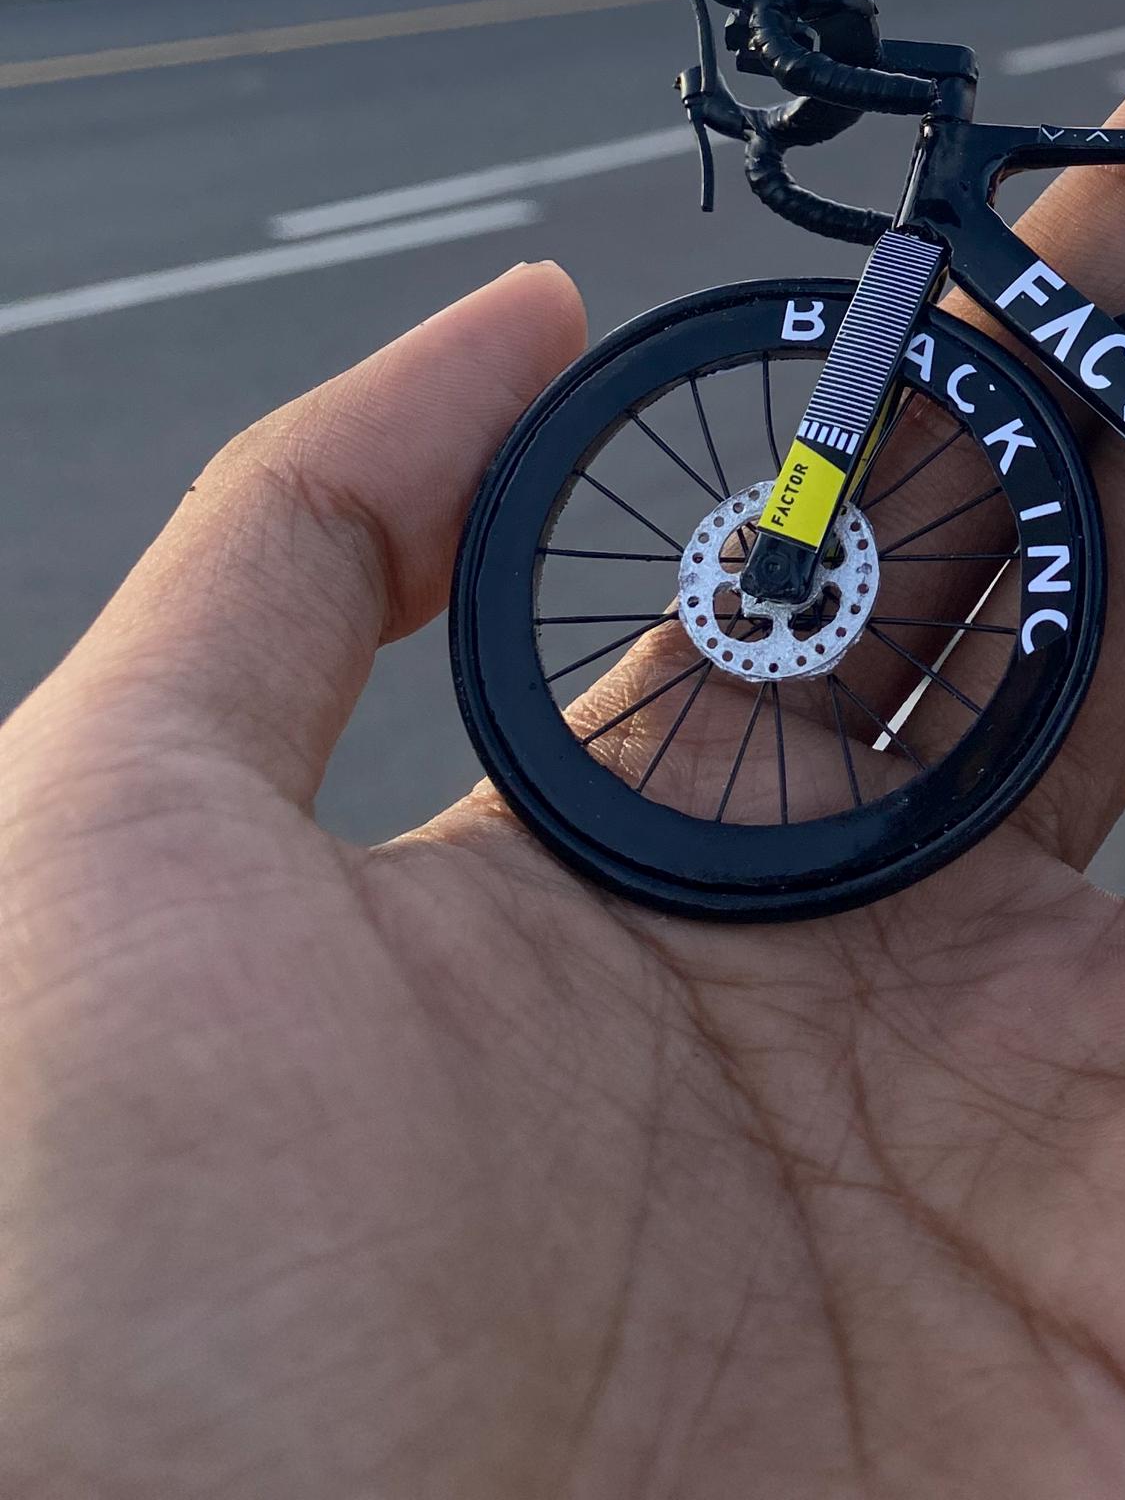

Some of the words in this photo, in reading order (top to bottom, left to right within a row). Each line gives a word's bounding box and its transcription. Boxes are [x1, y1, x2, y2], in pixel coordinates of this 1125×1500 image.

[771, 463, 809, 527] FACTOR
[781, 299, 1037, 476] BACK
[1019, 500, 1071, 655] INC
